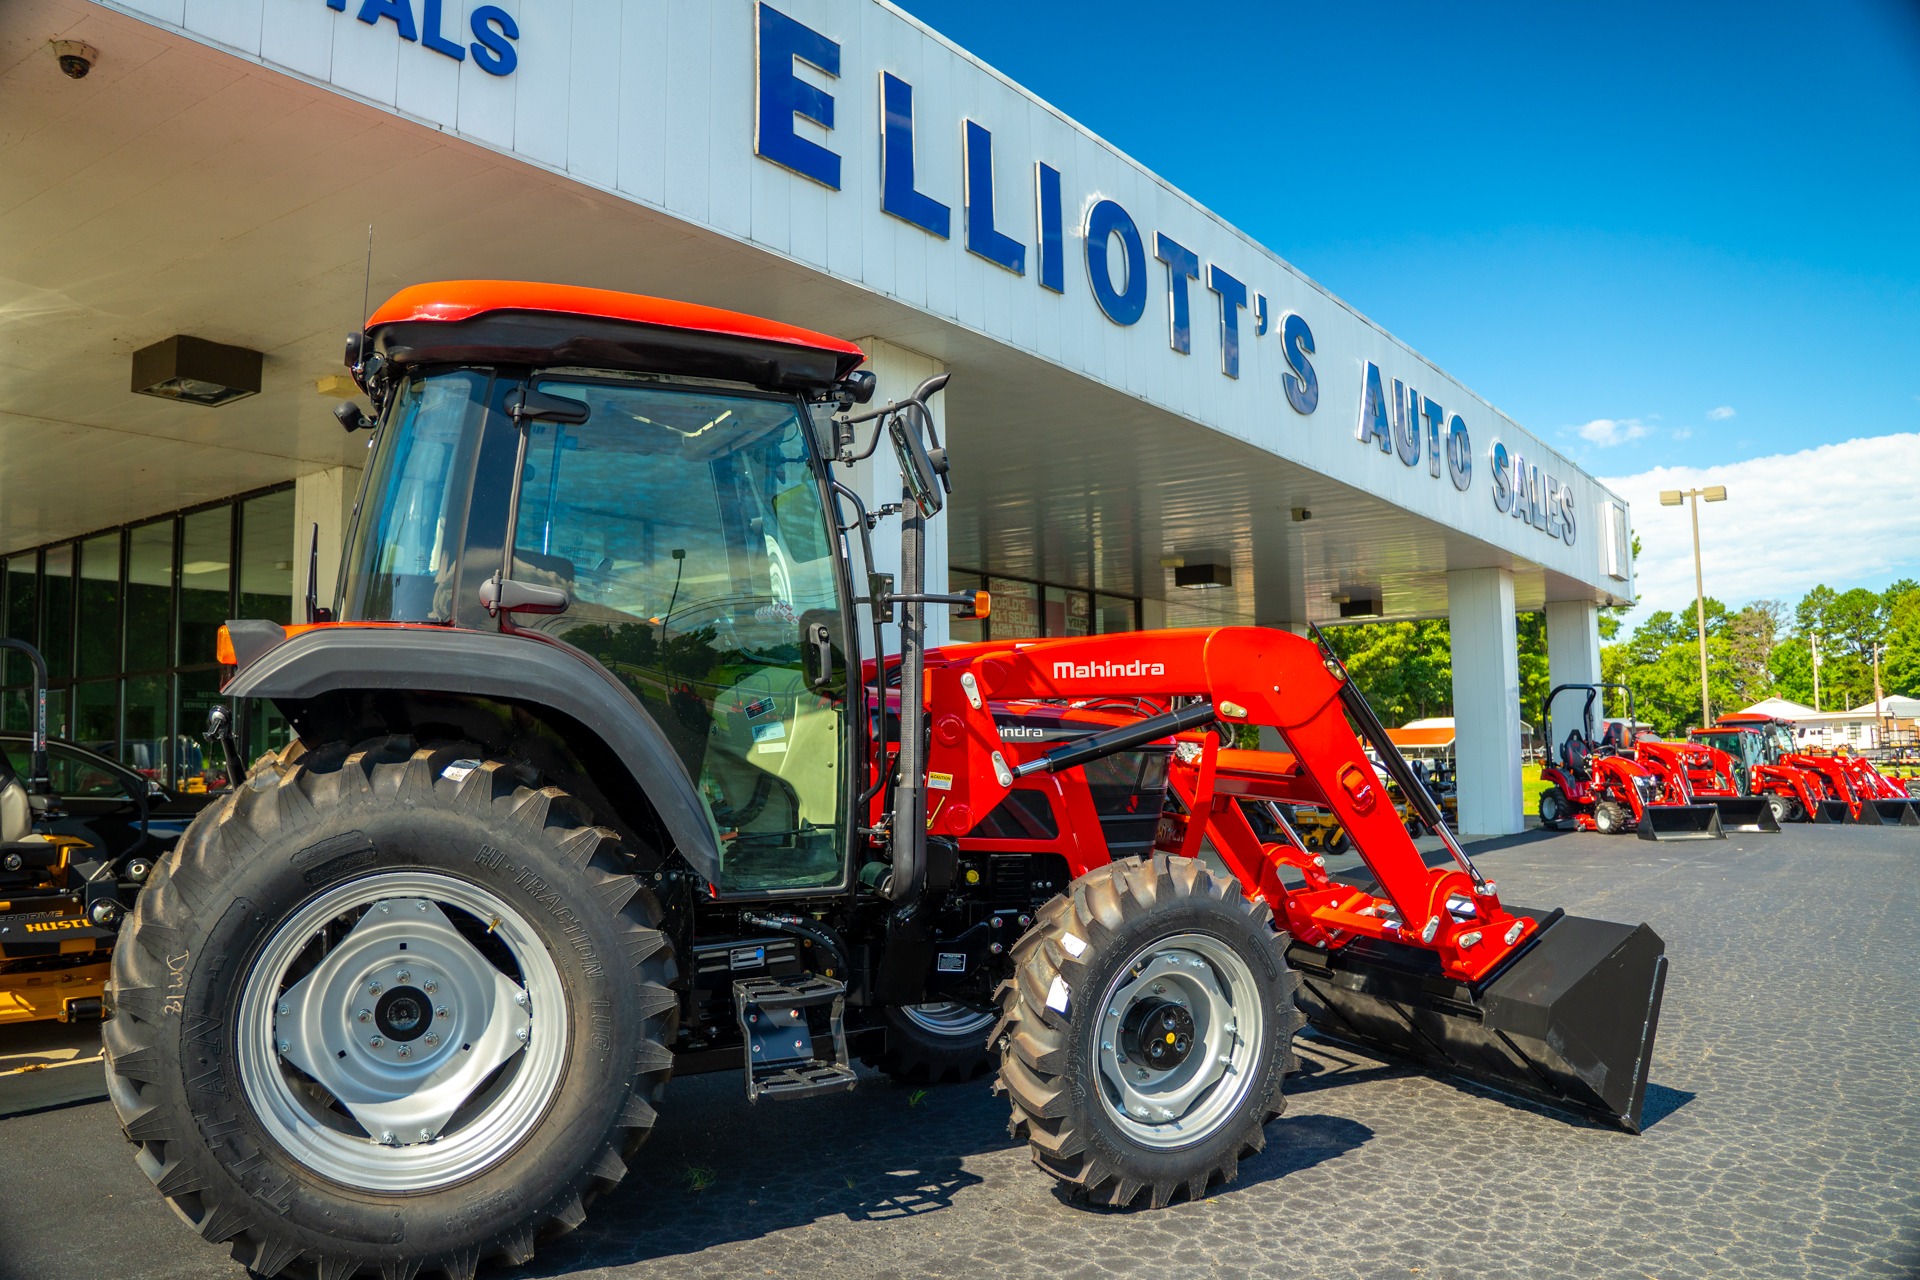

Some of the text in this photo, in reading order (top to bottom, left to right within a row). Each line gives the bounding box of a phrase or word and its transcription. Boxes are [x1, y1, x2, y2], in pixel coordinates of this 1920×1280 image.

[326, 0, 520, 77] ALS
[754, 1, 1576, 547] ELLIOTT'S AUTO SALES
[1053, 660, 1165, 679] Mahindra
[997, 725, 1043, 738] indra
[183, 1004, 307, 1217] TITAN
